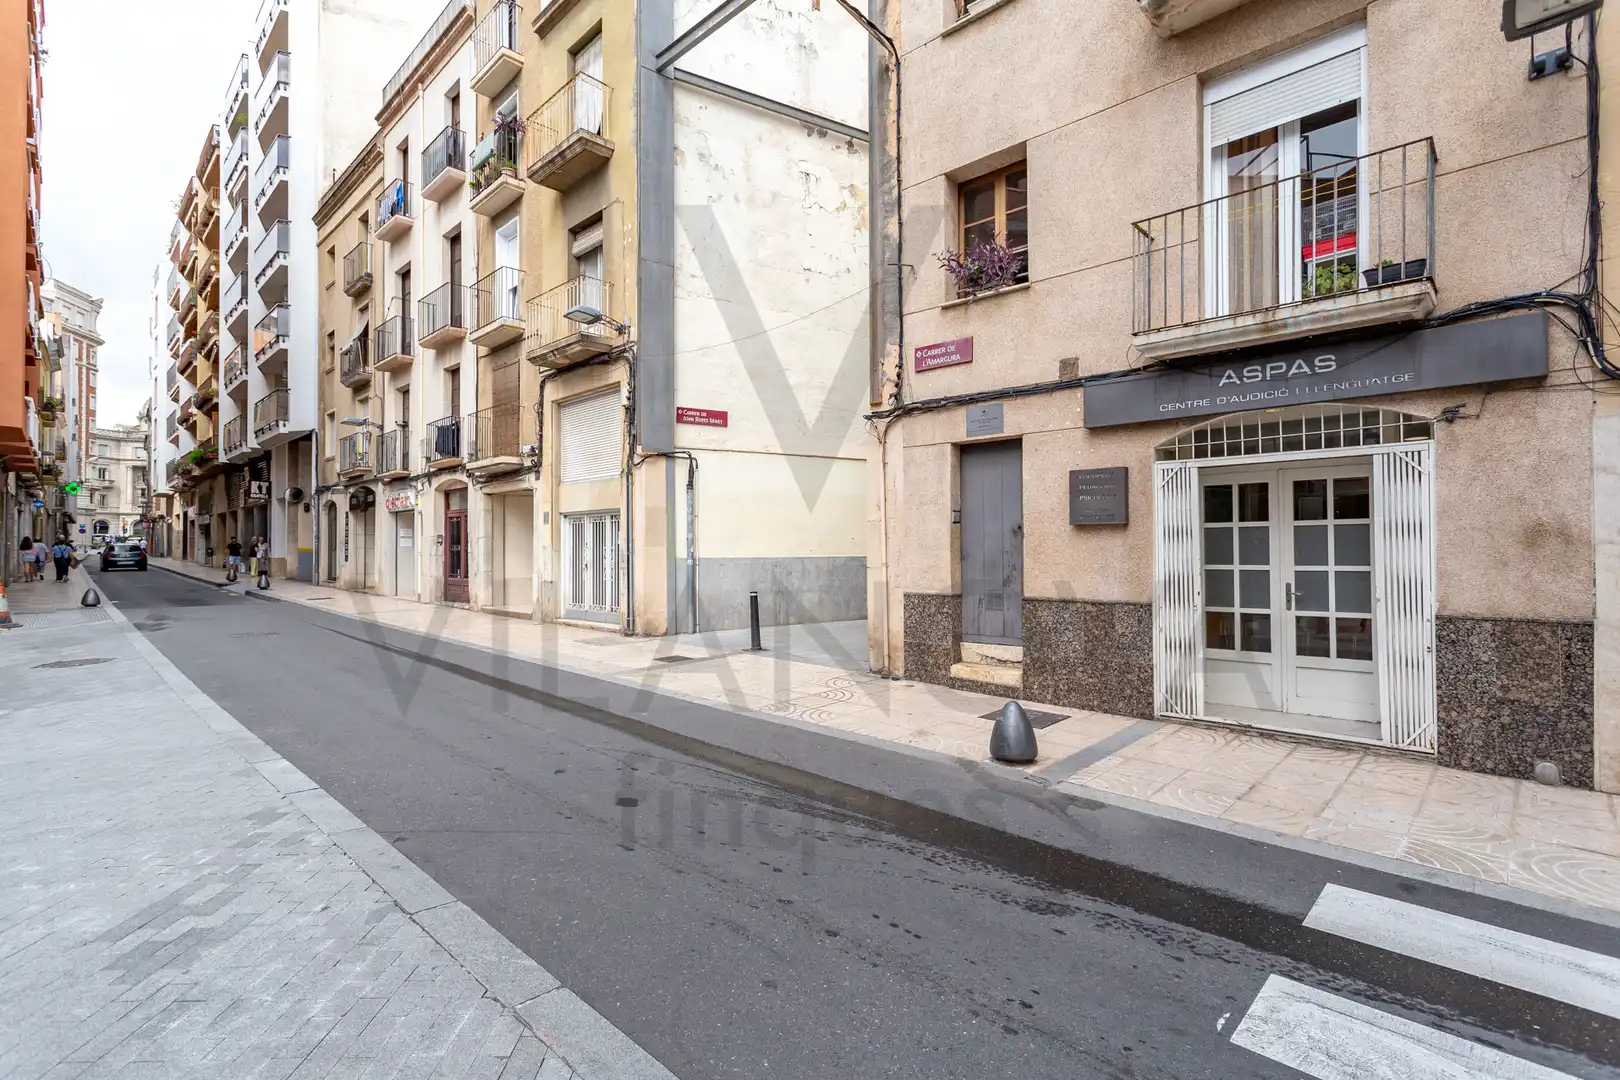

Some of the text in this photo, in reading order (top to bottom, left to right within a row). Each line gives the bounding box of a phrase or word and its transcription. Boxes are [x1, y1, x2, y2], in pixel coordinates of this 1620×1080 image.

[947, 345, 956, 353] DE
[1218, 354, 1337, 387] ASPAS
[1159, 398, 1211, 412] CENTRE
